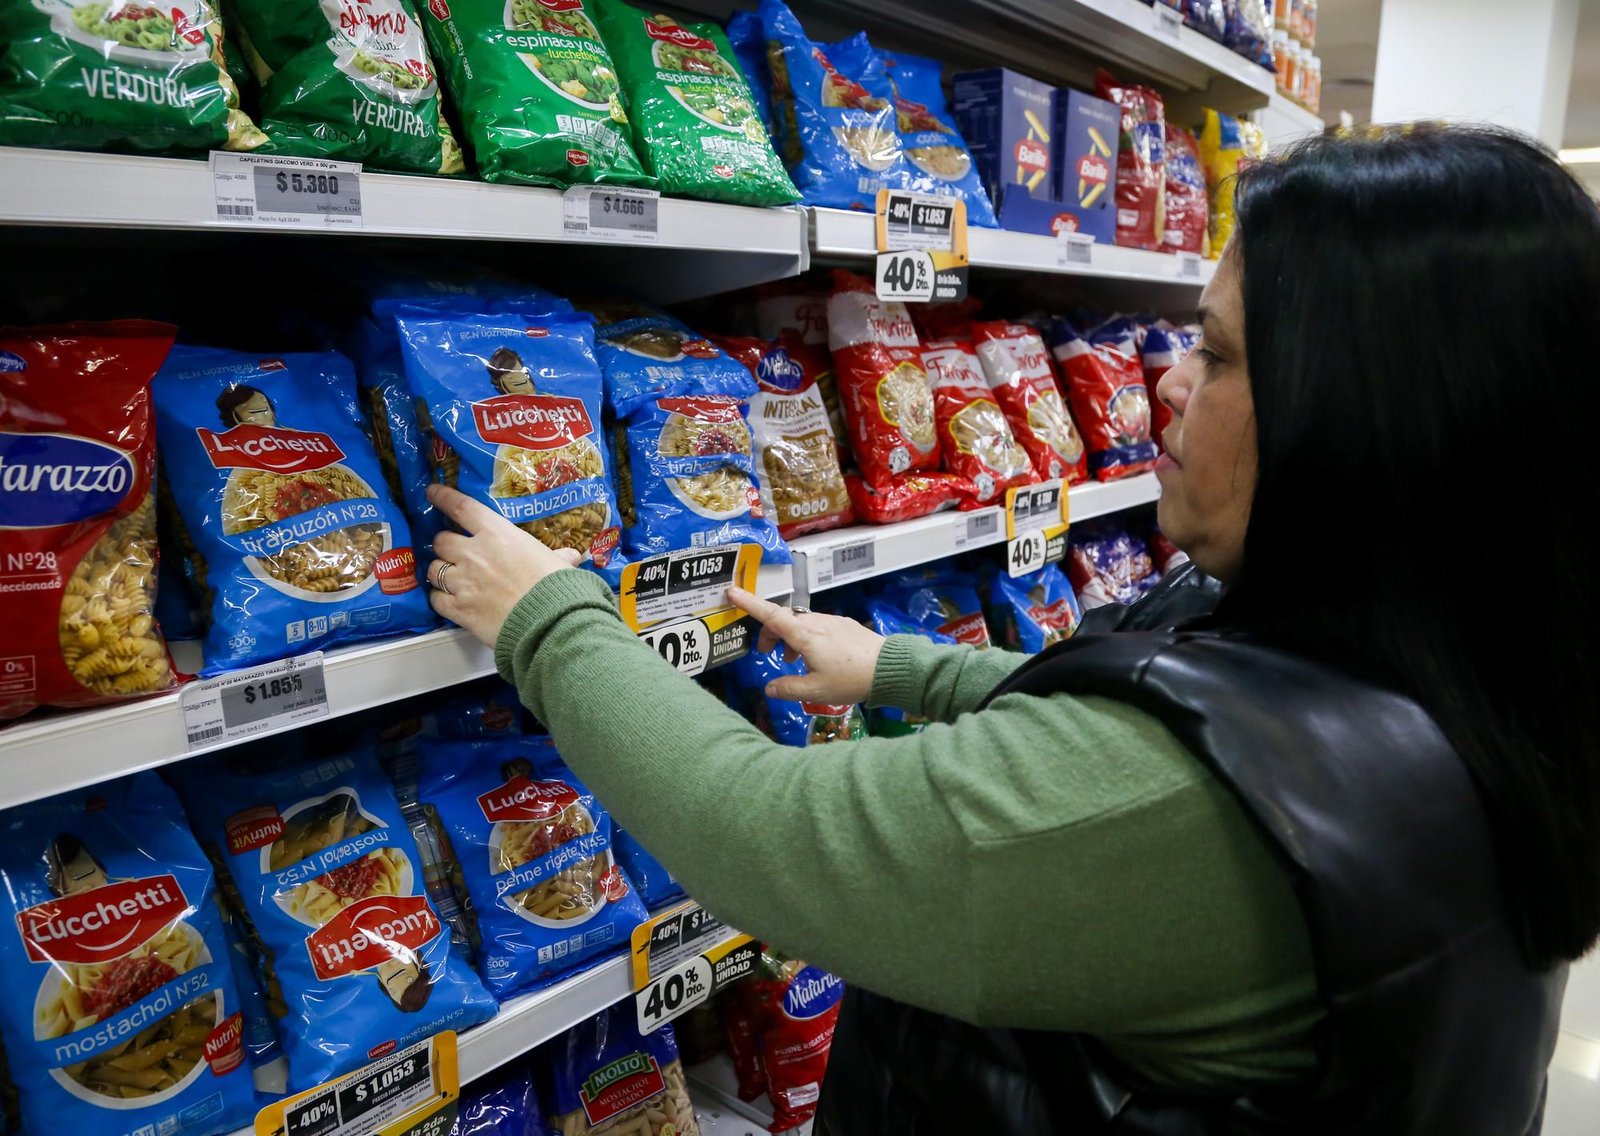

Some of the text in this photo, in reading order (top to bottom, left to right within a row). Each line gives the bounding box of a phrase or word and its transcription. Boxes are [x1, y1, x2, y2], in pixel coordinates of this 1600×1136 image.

[506, 33, 583, 51] espinaca y
[462, 56, 473, 80] queso
[656, 71, 711, 84] espinaca
[81, 67, 195, 108] VERDURA
[352, 98, 425, 138] VERDURA
[292, 174, 338, 195] 5.380
[613, 198, 644, 215] 4.666
[925, 208, 945, 225] 1.053
[883, 256, 915, 292] 40
[483, 404, 582, 431] Lucchetti
[763, 396, 821, 419] INTEGRAL
[502, 488, 577, 519] tirabuzón
[240, 504, 378, 553] tirabuzón N°28
[1012, 538, 1032, 568] 40
[692, 556, 723, 577] 1.053
[228, 635, 256, 650] 500g
[683, 630, 697, 650] %
[714, 625, 748, 643] En la 2da.
[683, 651, 702, 665] Dto.
[713, 638, 742, 657] UNIDAD
[244, 674, 302, 704] $ 1.855
[233, 821, 282, 849] NutriVit
[275, 831, 389, 885] mostachol N°52
[495, 865, 543, 894] penne
[545, 845, 578, 872] rigate
[30, 883, 172, 943] Lucchetti
[320, 909, 434, 970] Luccetti
[487, 959, 510, 970] 500g
[716, 949, 755, 973] En la 2da.
[716, 960, 751, 983] UNIDAD
[685, 966, 699, 986] %
[644, 974, 684, 1020] 40
[686, 983, 705, 999] Dto.
[54, 973, 209, 1062] mostachol N°52
[206, 1018, 243, 1056] NutriVit
[369, 1041, 396, 1057] Lucchetti
[399, 1015, 445, 1045] mostachol
[363, 1053, 398, 1073] MOSTACHOL
[593, 1057, 640, 1087] MOLTO
[355, 1059, 415, 1101] $ 1.053
[600, 1077, 650, 1108] MOSTACHOL
[611, 1090, 645, 1111] RAYADO
[422, 1116, 448, 1133] 2da.
